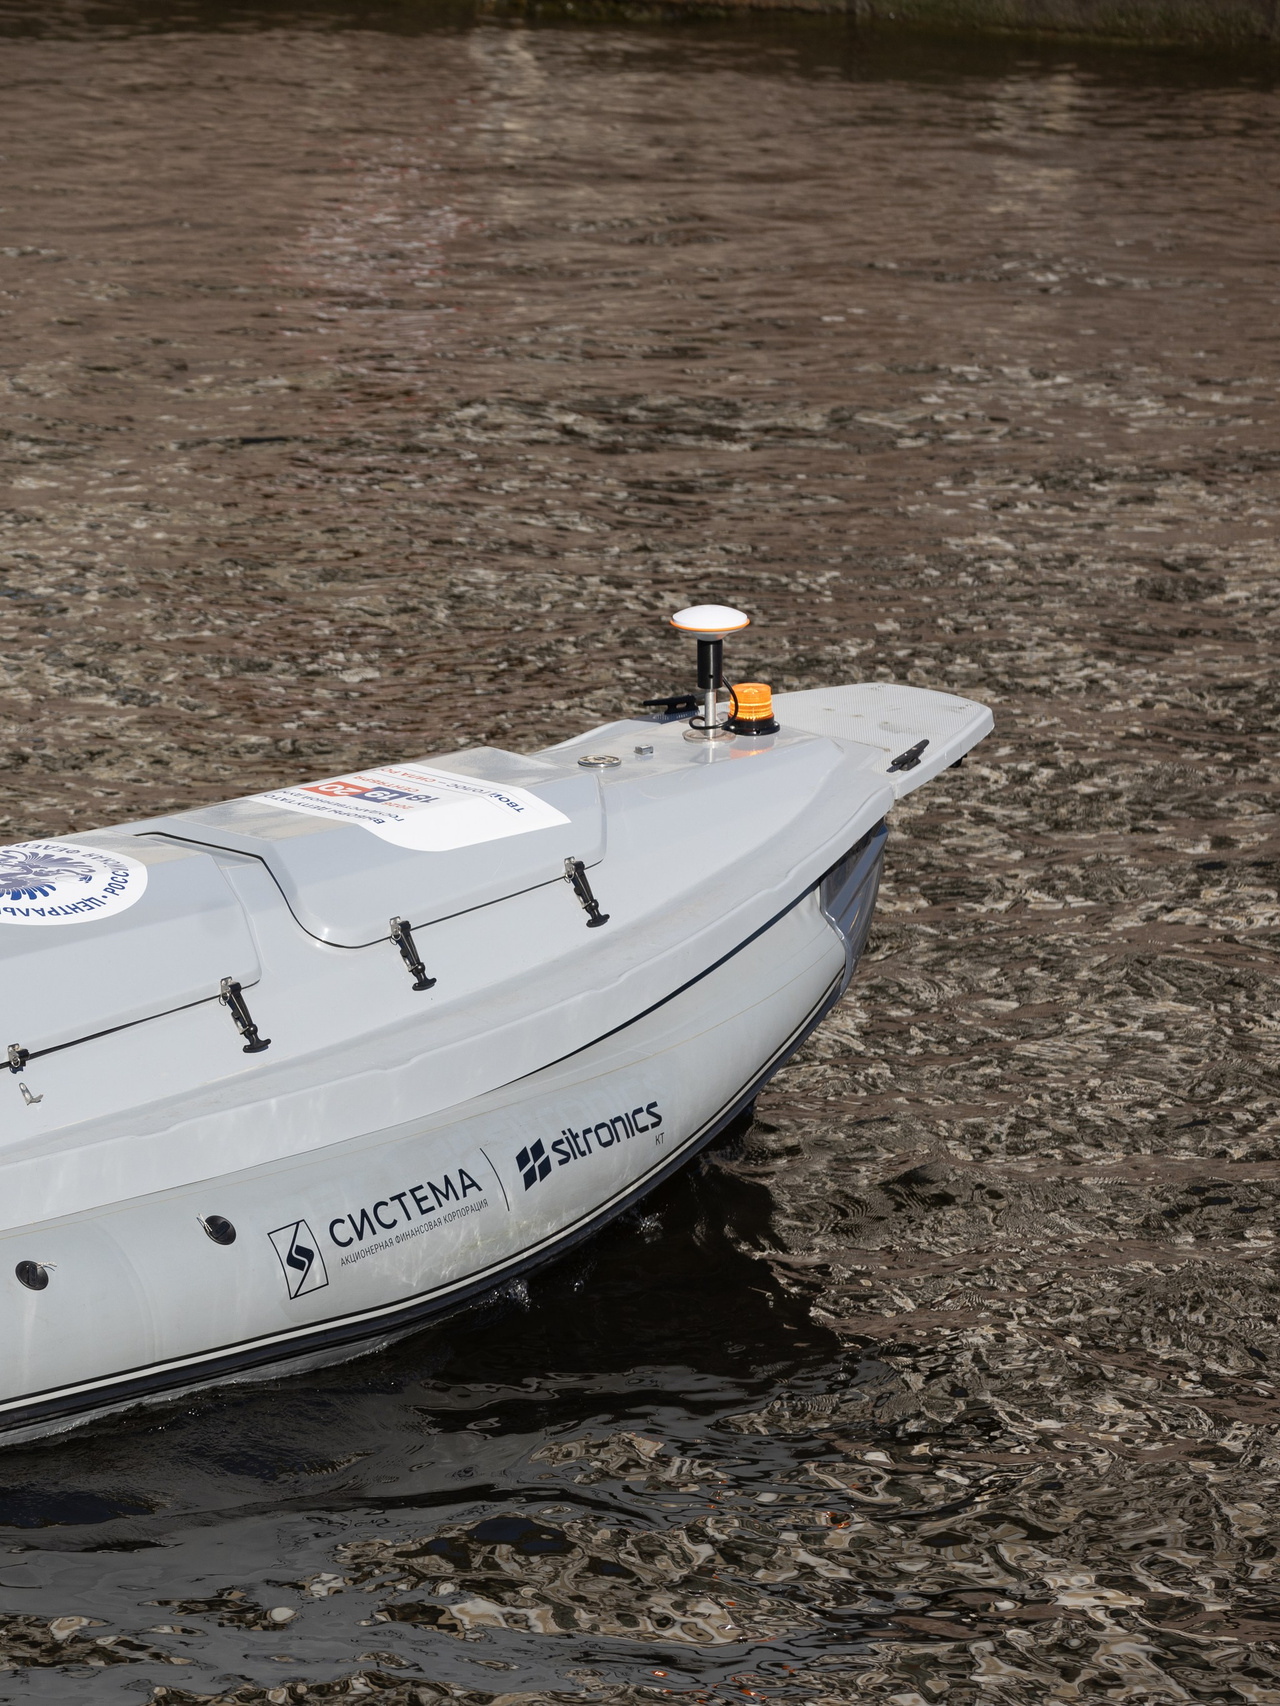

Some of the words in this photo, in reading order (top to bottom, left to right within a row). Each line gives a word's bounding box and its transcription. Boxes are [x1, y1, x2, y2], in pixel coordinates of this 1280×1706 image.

[318, 784, 362, 796] 20
[354, 775, 419, 793] СЕНТЯБРЯ
[446, 782, 491, 795] ГОЛОС
[263, 794, 327, 812] ДЕПУТАТО
[364, 790, 399, 800] 19
[405, 794, 440, 803] 18
[491, 791, 525, 813] ТВОЙ
[551, 1100, 663, 1167] sitronics
[328, 1168, 483, 1248] СИСТЕМА
[340, 1238, 395, 1267] АКЦИОНЕРНАЯ
[394, 1217, 443, 1244] ФИНАНСОВАЯ
[443, 1198, 489, 1225] КОРПОРАЦИЯ
